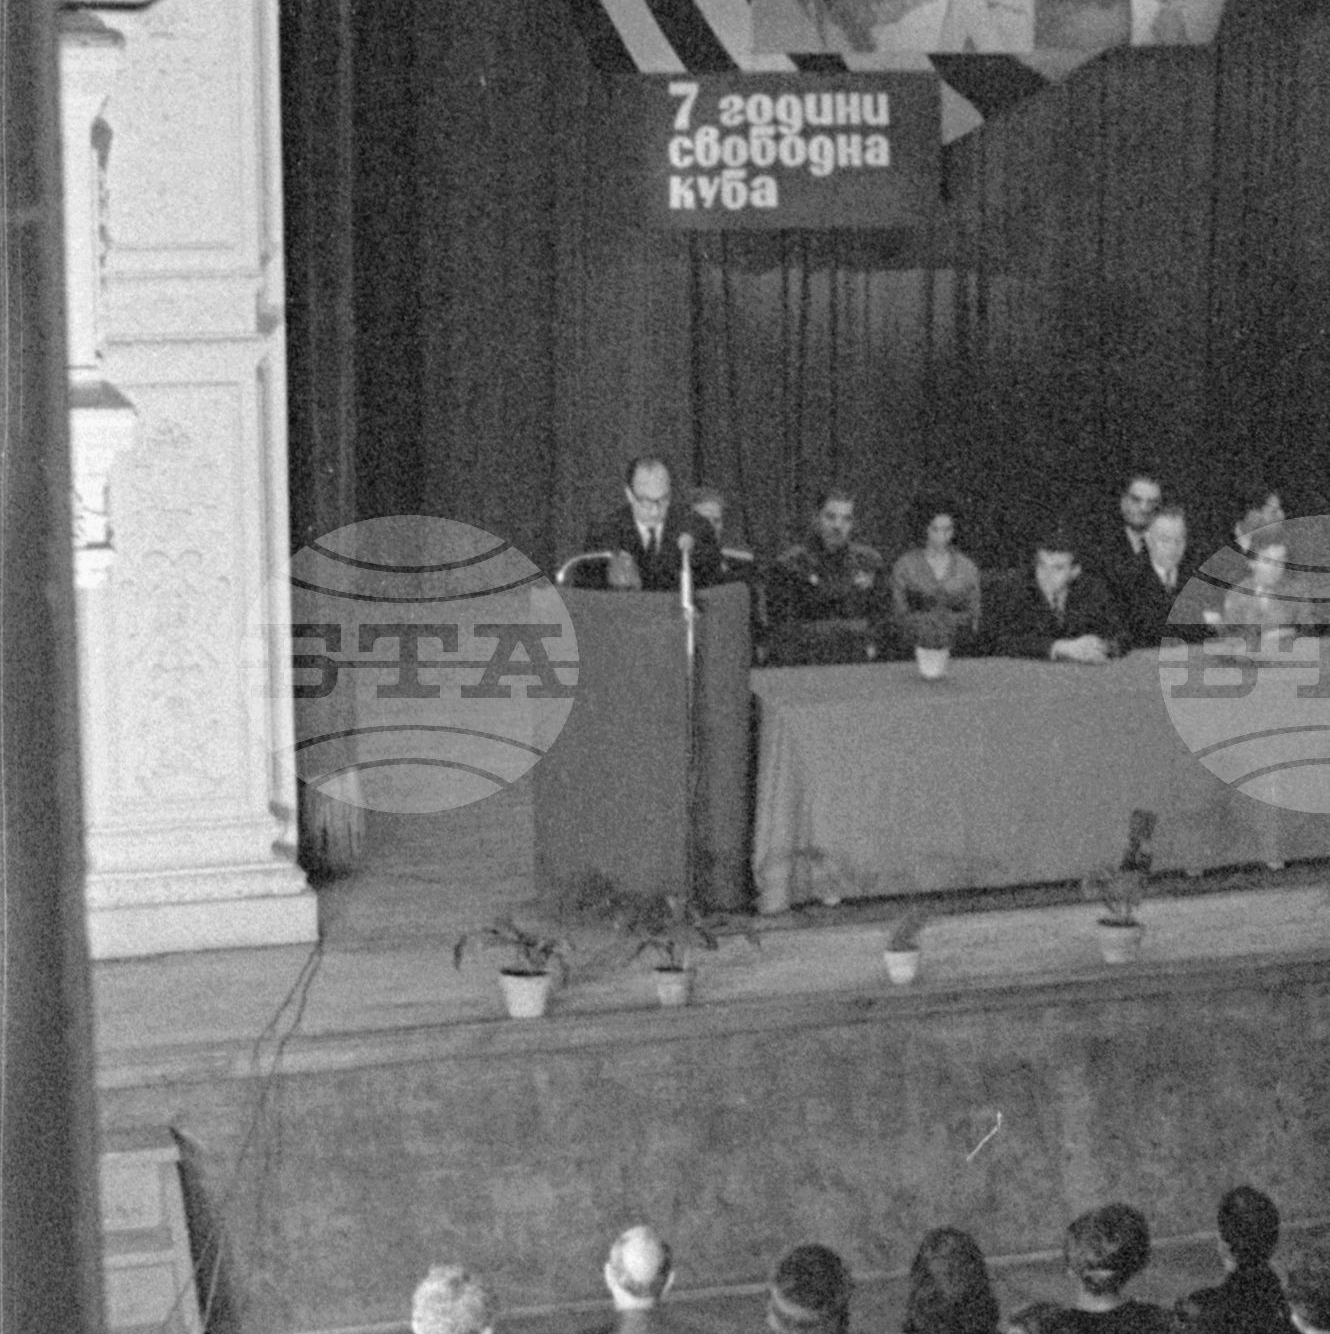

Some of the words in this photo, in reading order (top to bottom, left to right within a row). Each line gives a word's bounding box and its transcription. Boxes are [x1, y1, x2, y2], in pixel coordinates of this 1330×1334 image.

[667, 81, 699, 130] 7
[718, 92, 890, 135] години
[667, 125, 891, 176] свободна
[668, 168, 779, 210] куба
